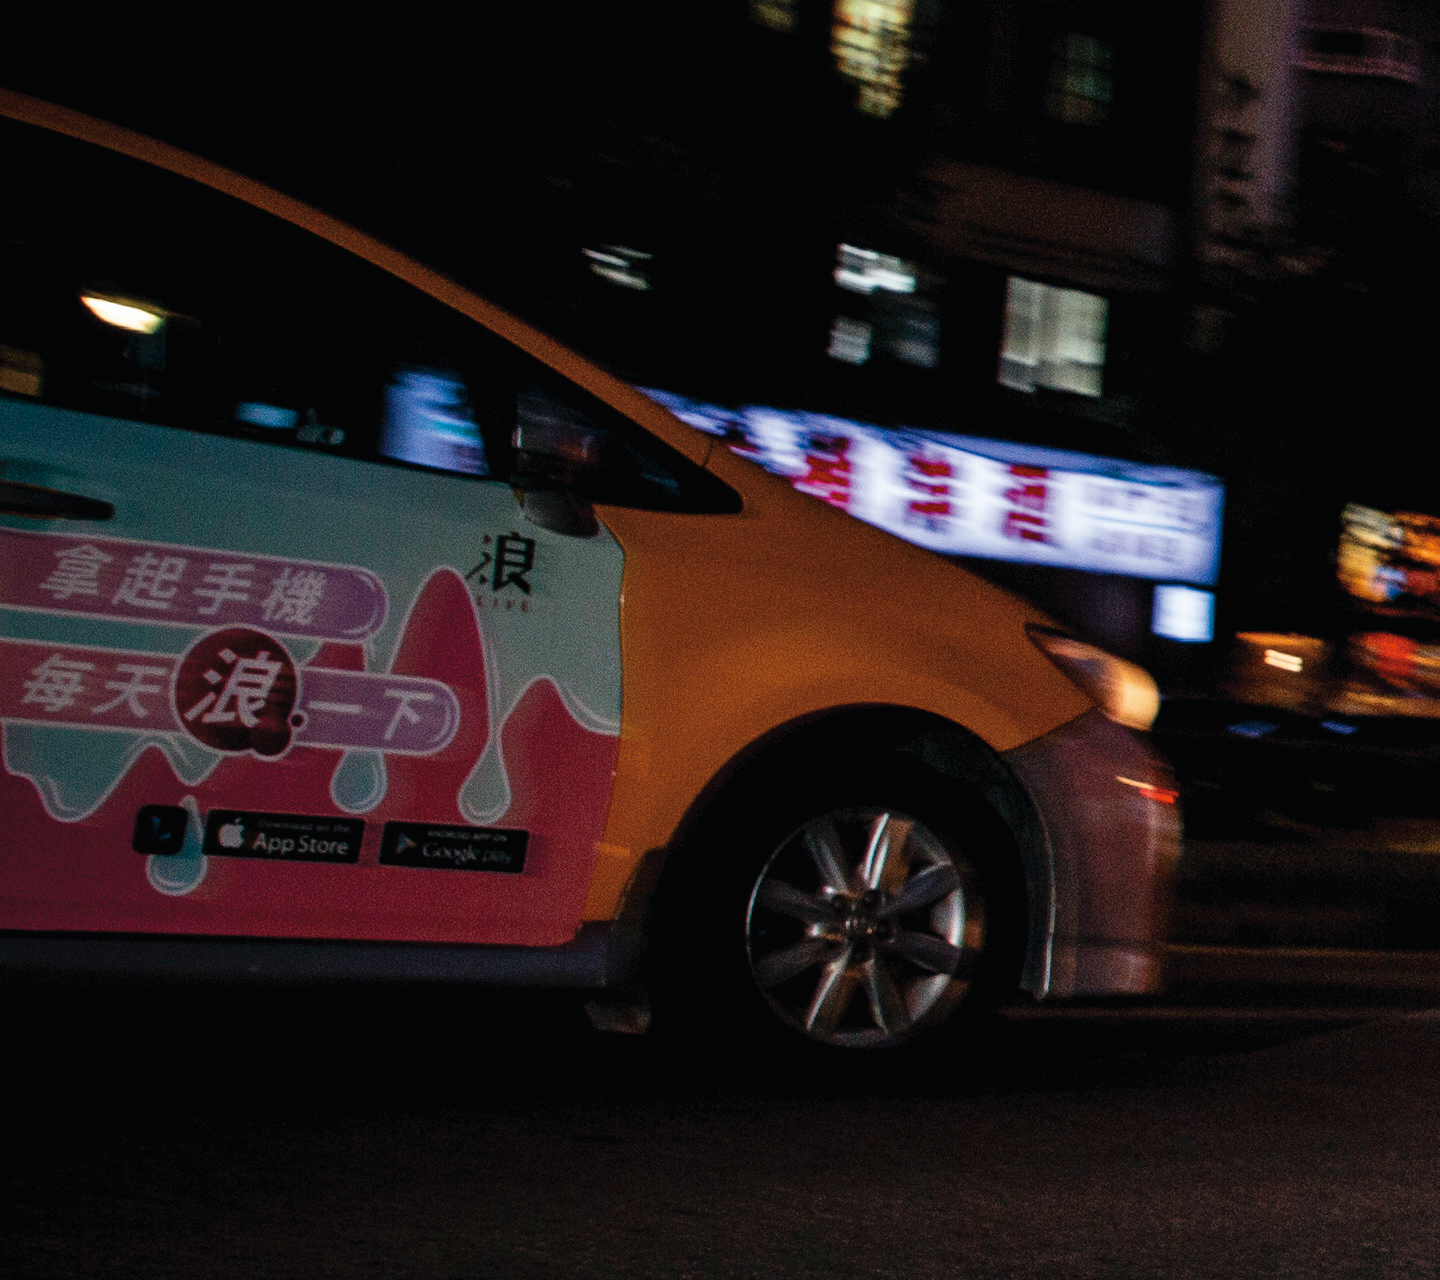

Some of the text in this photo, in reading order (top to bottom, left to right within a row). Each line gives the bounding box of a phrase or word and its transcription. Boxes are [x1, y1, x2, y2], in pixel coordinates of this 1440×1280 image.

[40, 544, 327, 624] 拿起手機
[464, 530, 536, 595] 浪
[22, 648, 434, 741] 每天浪一下
[252, 832, 349, 856] App Store
